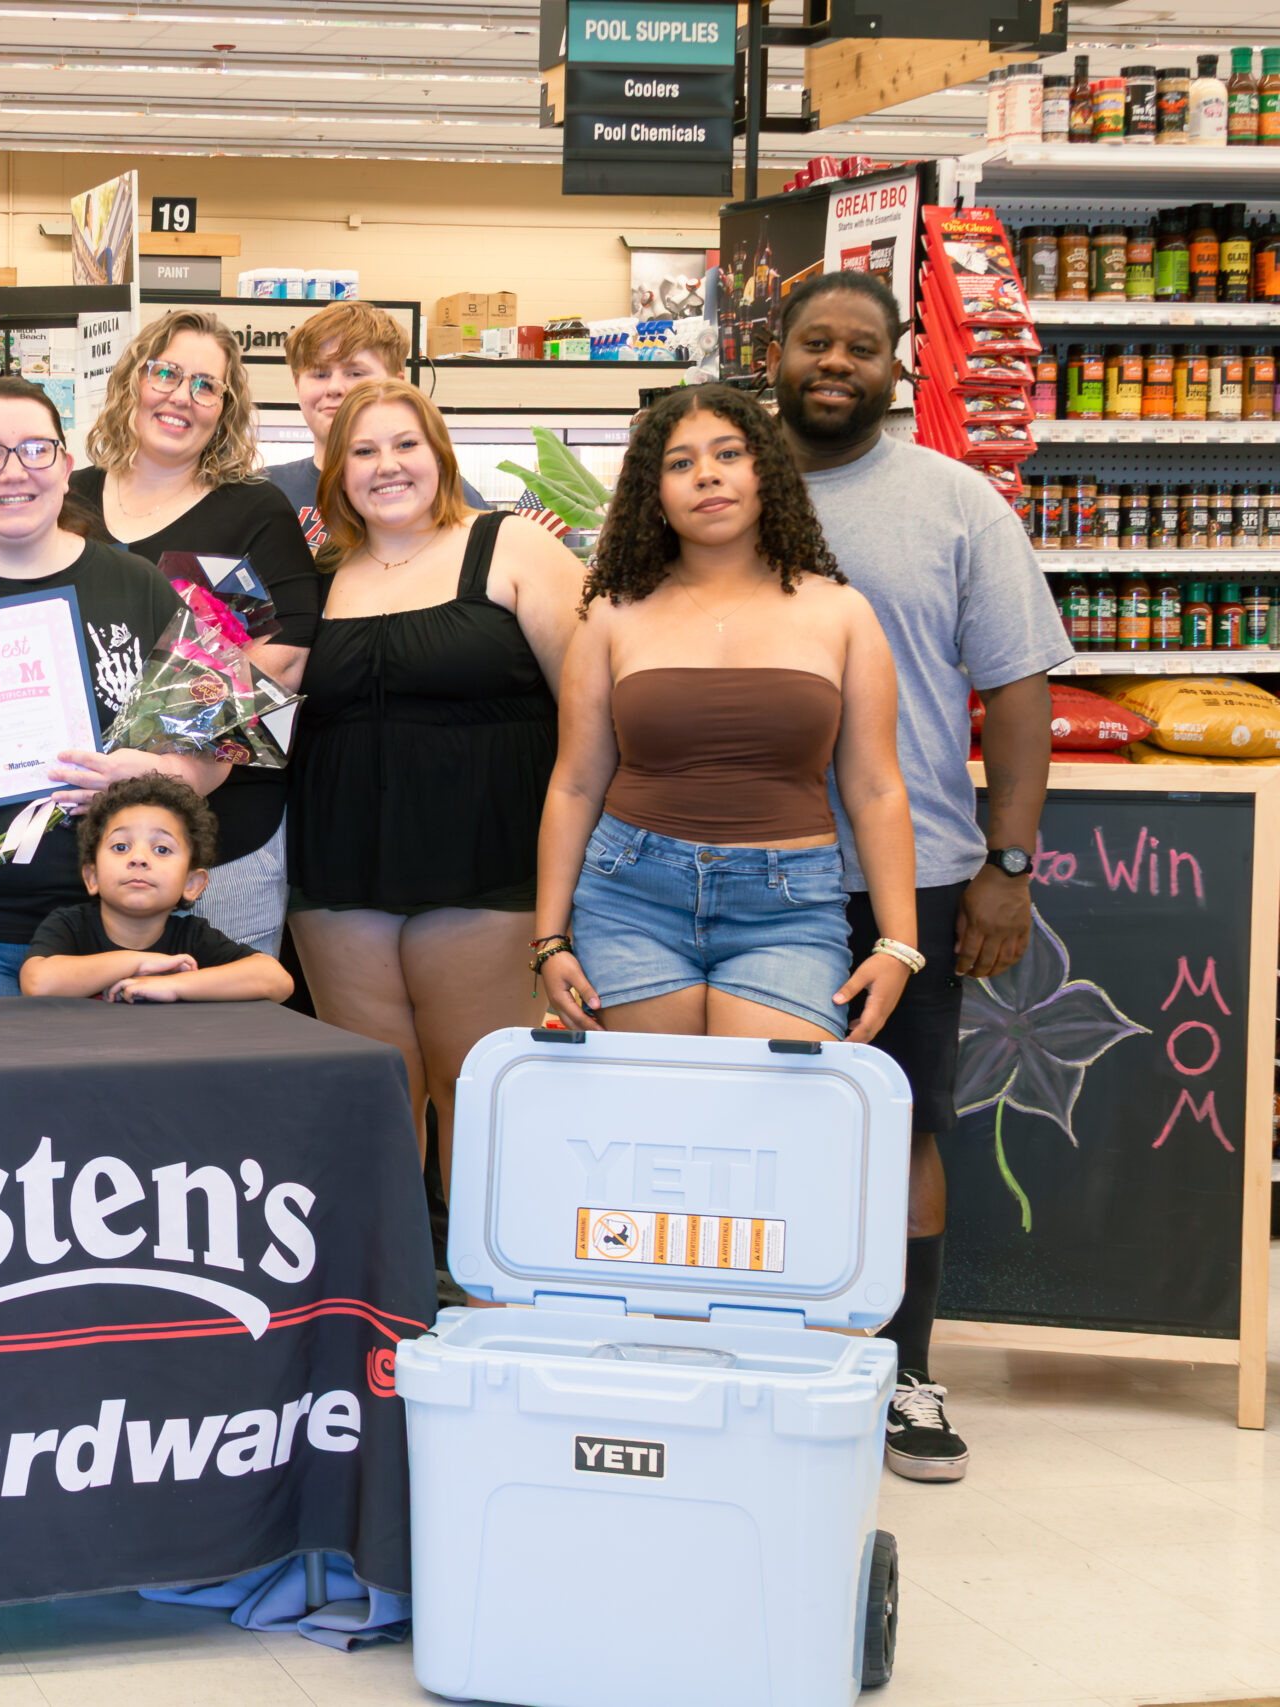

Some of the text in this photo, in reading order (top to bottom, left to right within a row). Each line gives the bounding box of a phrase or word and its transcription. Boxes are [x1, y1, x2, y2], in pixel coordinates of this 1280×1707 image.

[585, 20, 719, 43] POOL SUPPLIES
[624, 78, 680, 98] Coolers
[594, 123, 706, 143] Pool Chemicals
[835, 184, 907, 219] GREAT BBQ
[158, 204, 191, 232] 19
[838, 222, 853, 232] Starts
[854, 220, 865, 228] with
[875, 213, 901, 224] Essentials
[965, 223, 993, 233] Glove
[158, 266, 190, 279] PAINT
[83, 317, 119, 339] MAGNOLIA
[92, 341, 111, 358] HOME
[1098, 721, 1128, 731] APPLE
[1098, 731, 1128, 741] BLEND
[8, 759, 40, 770] Maricopa
[1094, 826, 1206, 905] Win
[1152, 956, 1235, 1152] MOM
[566, 1138, 778, 1213] YETI
[578, 1441, 661, 1474] YETI
